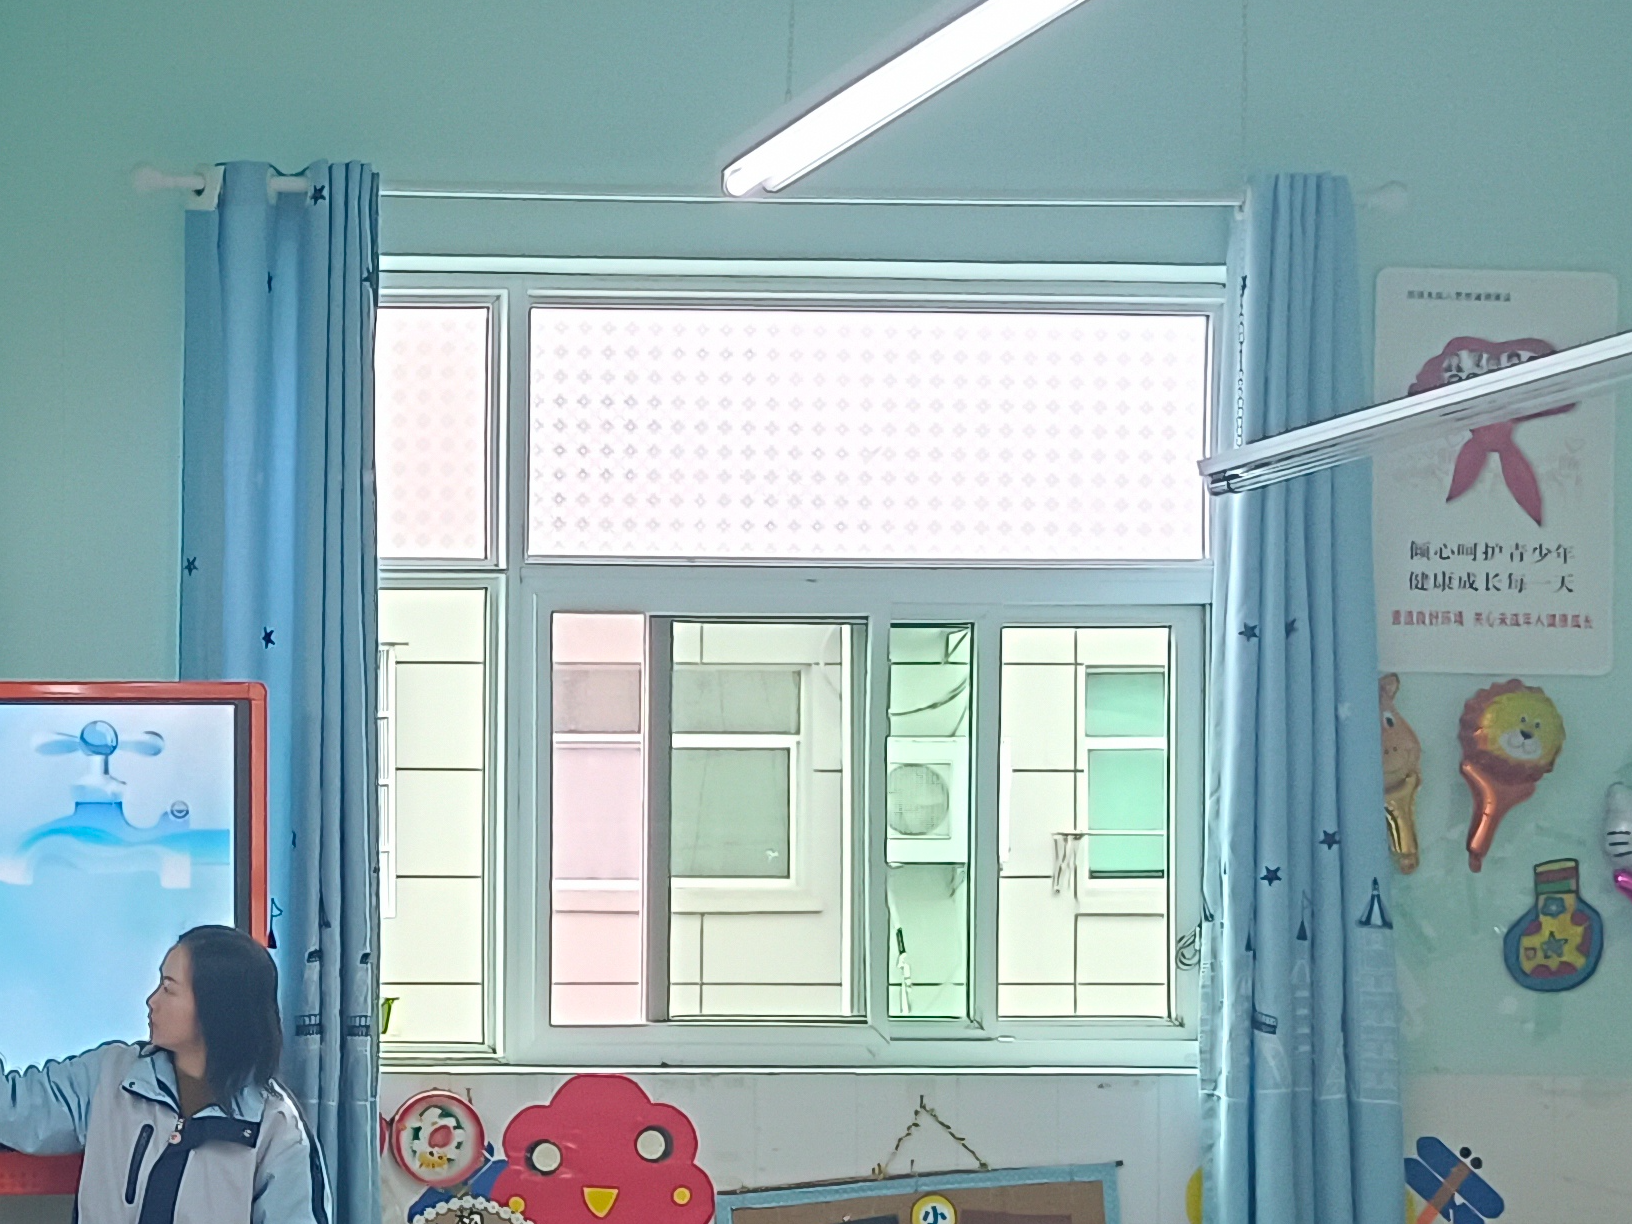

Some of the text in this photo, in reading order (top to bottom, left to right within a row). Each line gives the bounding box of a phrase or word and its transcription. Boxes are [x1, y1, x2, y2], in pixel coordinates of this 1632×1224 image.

[1410, 540, 1576, 564] 倾心呵护青少年
[1409, 571, 1574, 593] 健康成长每一天
